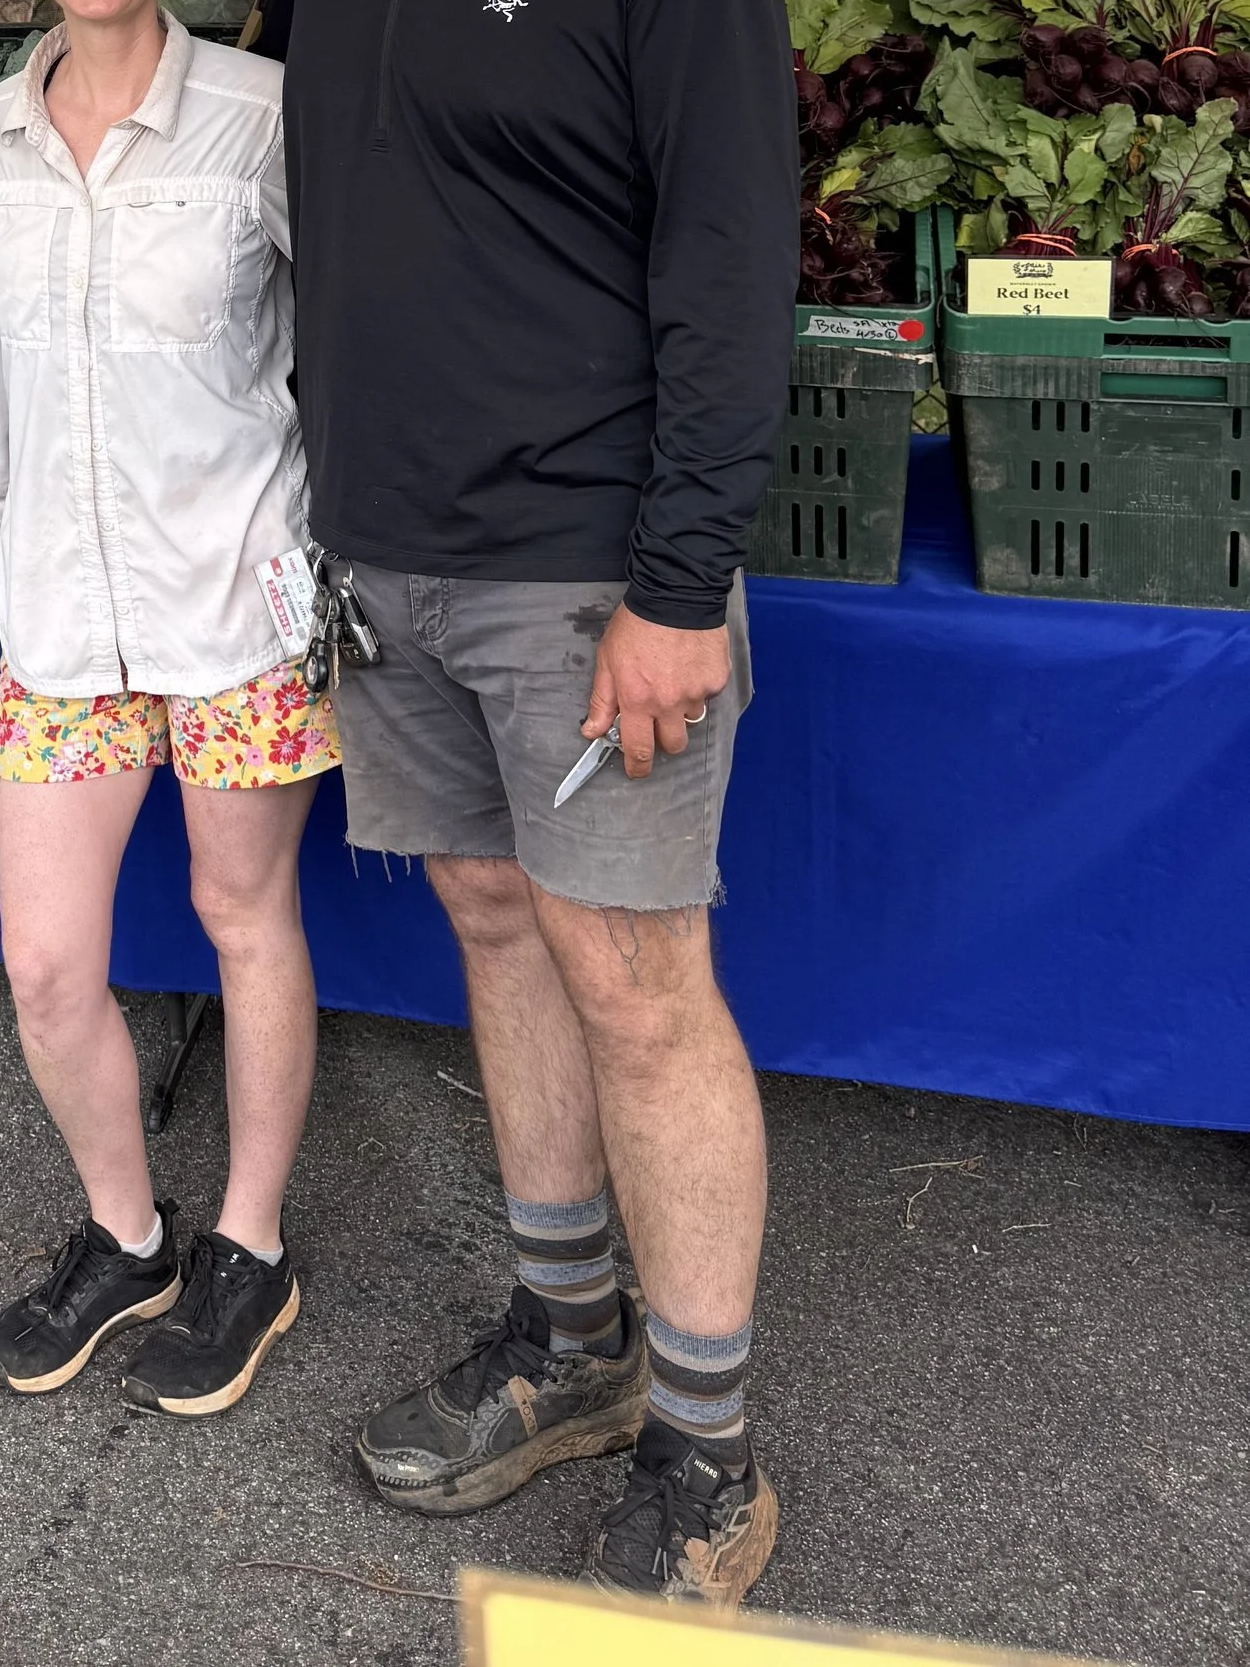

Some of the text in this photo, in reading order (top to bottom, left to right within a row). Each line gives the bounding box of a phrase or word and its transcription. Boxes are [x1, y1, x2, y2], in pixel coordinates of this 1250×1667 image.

[997, 287, 1069, 299] Red Beet
[1023, 304, 1041, 315] $4
[269, 583, 292, 635] SHEETZ
[693, 1459, 718, 1479] HIERRO
